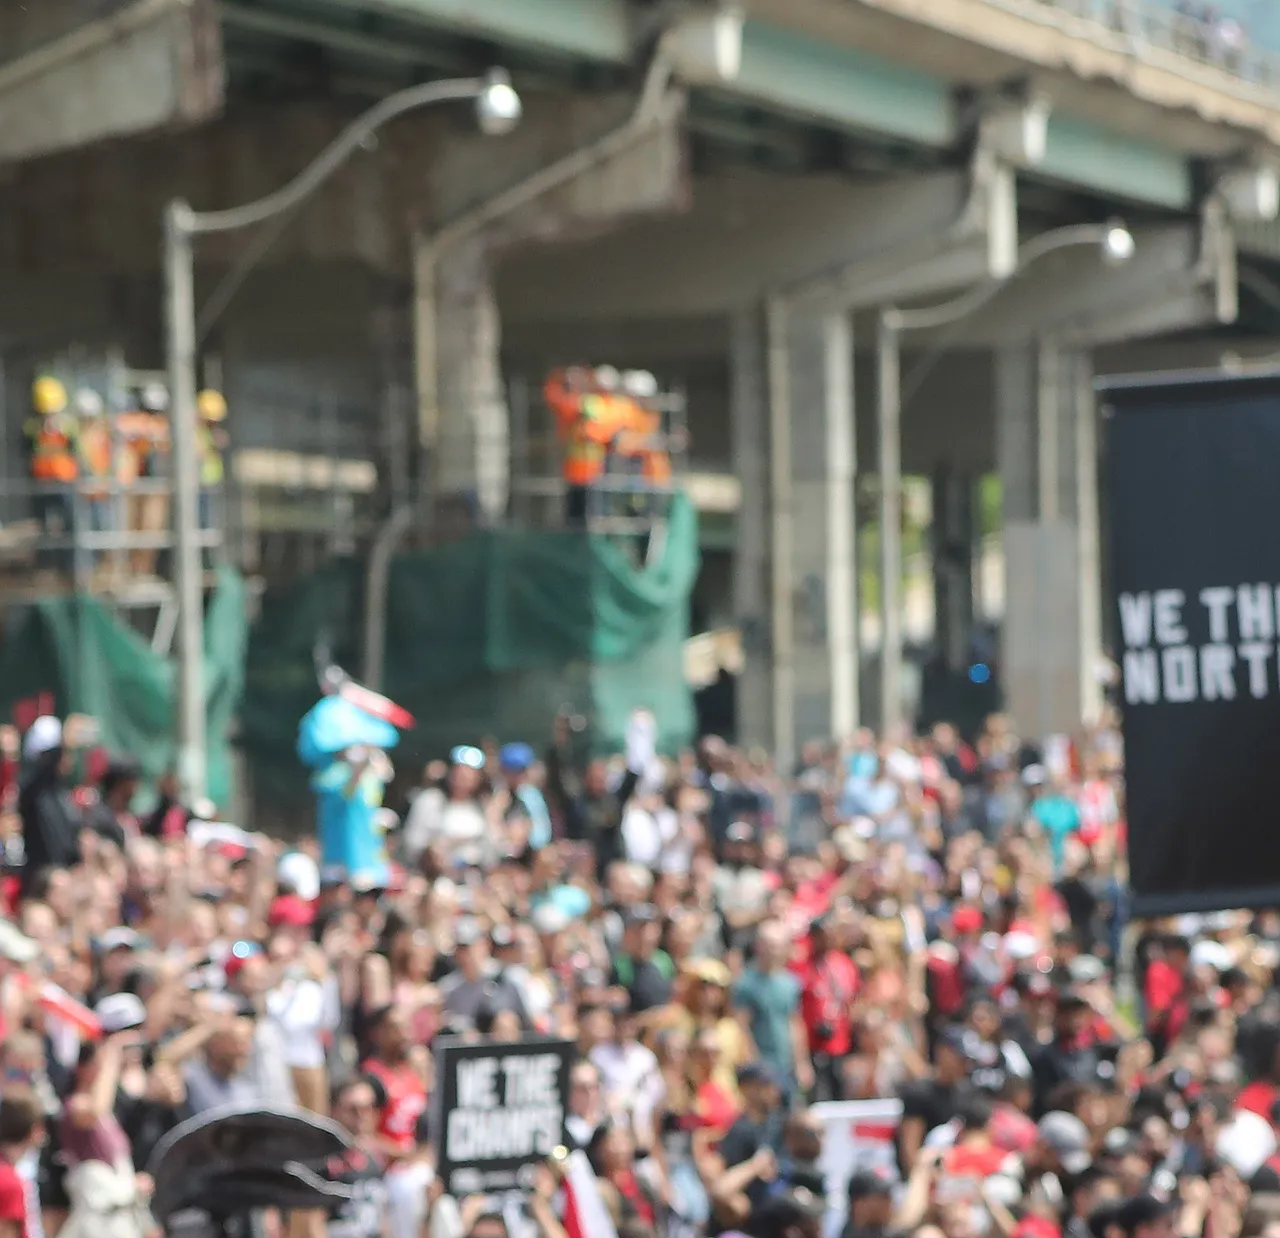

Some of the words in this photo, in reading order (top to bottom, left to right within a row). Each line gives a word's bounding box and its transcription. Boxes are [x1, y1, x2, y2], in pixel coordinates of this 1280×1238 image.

[1118, 588, 1188, 649] WE
[456, 1056, 501, 1109] WE
[500, 1051, 563, 1108] THE
